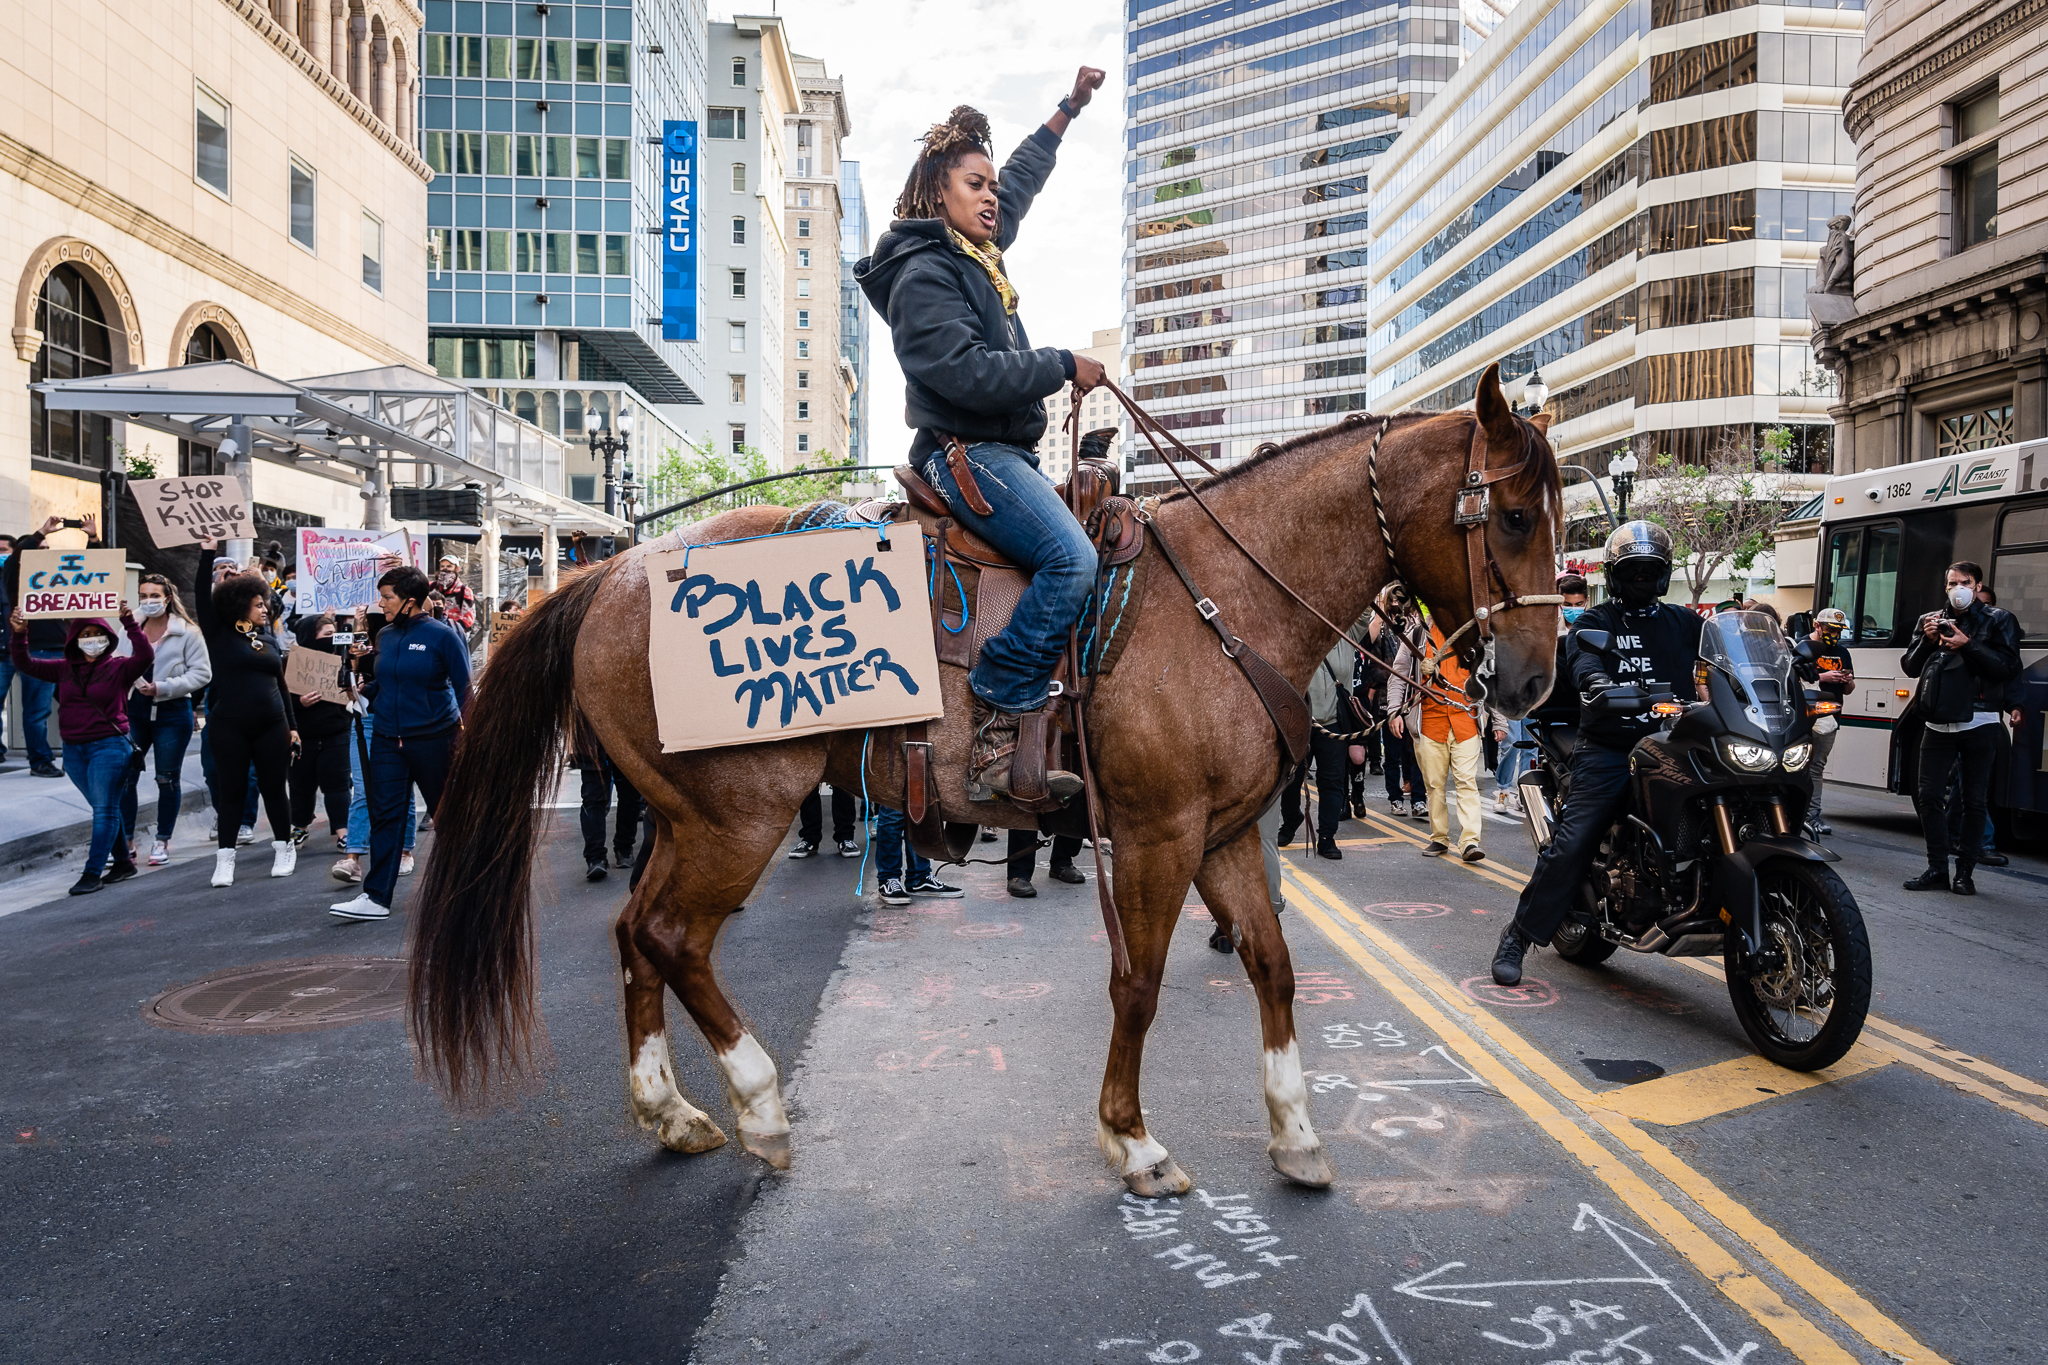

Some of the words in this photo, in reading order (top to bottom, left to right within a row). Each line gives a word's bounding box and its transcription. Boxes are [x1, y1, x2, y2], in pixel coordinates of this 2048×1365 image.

[670, 158, 690, 252] CHASE
[1886, 482, 1912, 499] 1362
[1972, 468, 2009, 482] TRANSIT
[58, 555, 85, 571] I
[505, 547, 567, 560] CHAE
[29, 571, 110, 590] CANT
[25, 592, 119, 614] BREATHE
[671, 557, 901, 635] BLACK
[710, 614, 857, 677] LIVES
[1616, 635, 1643, 650] WE
[1618, 657, 1653, 673] ARE
[297, 671, 316, 687] NO
[735, 647, 920, 728] MATTER
